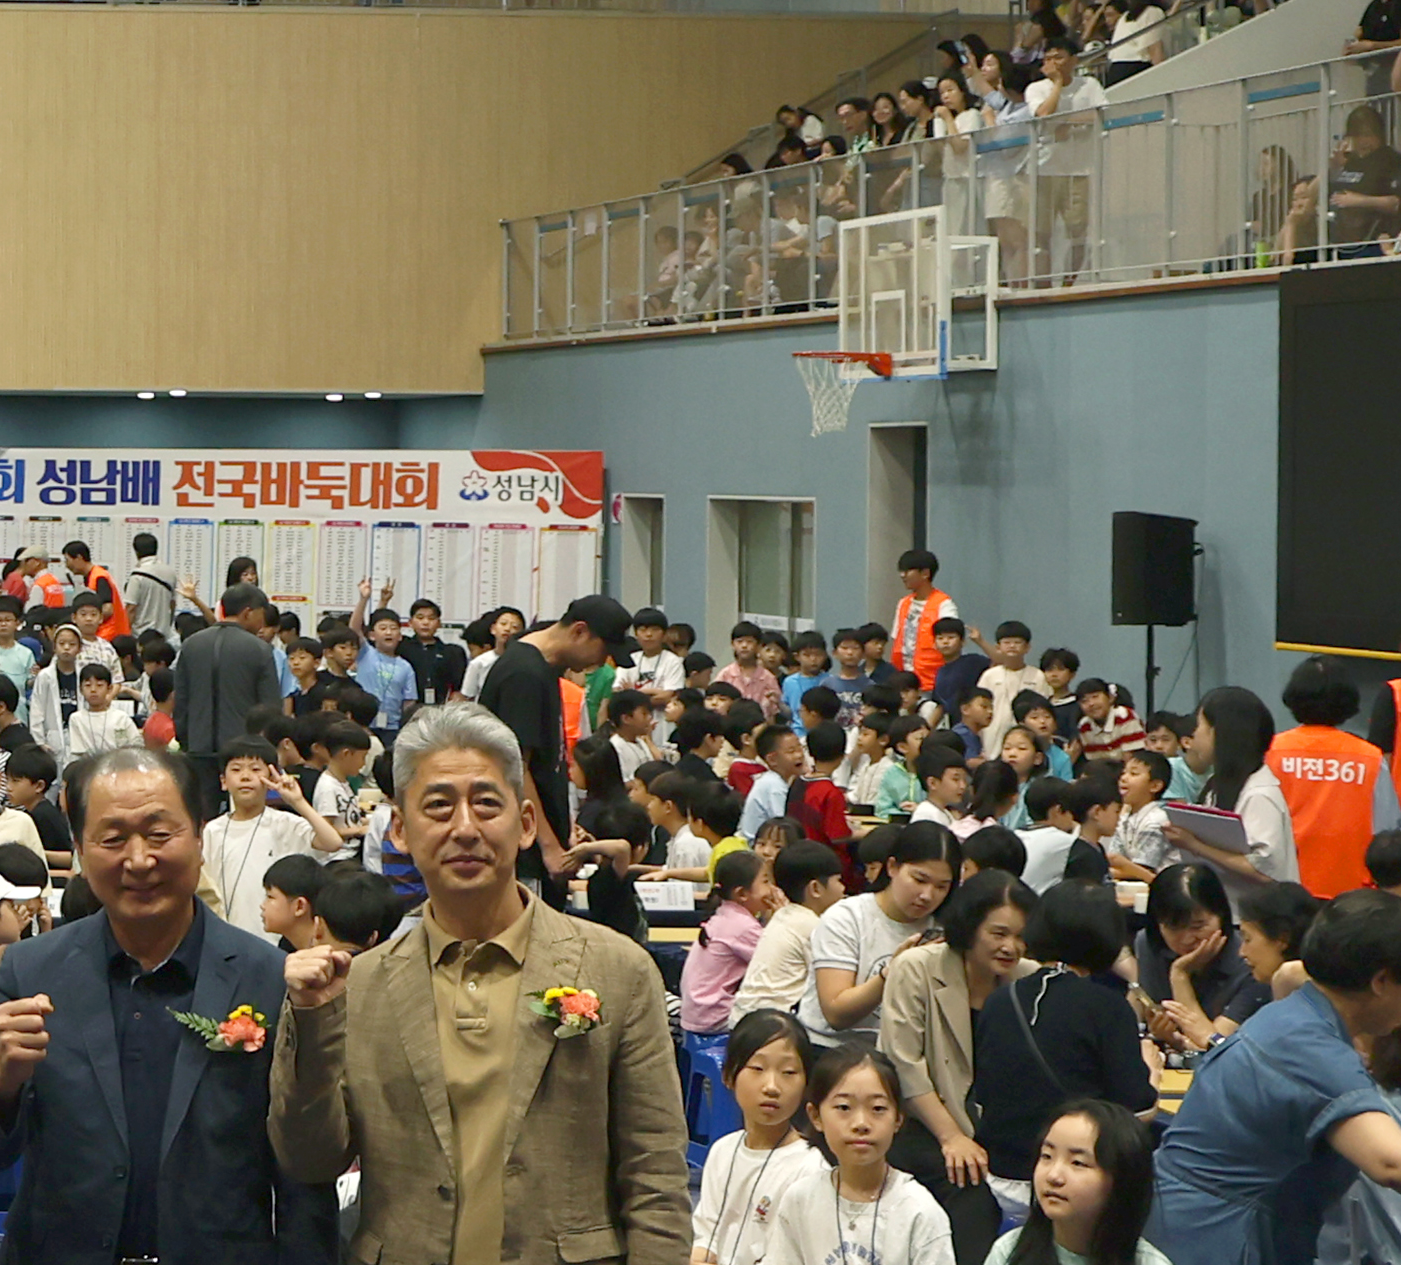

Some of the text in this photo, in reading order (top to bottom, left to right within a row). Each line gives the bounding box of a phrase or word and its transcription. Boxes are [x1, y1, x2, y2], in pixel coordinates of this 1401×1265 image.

[37, 458, 160, 506] 성남배
[172, 460, 440, 510] 전국바둑대회
[492, 470, 561, 505] 성남시
